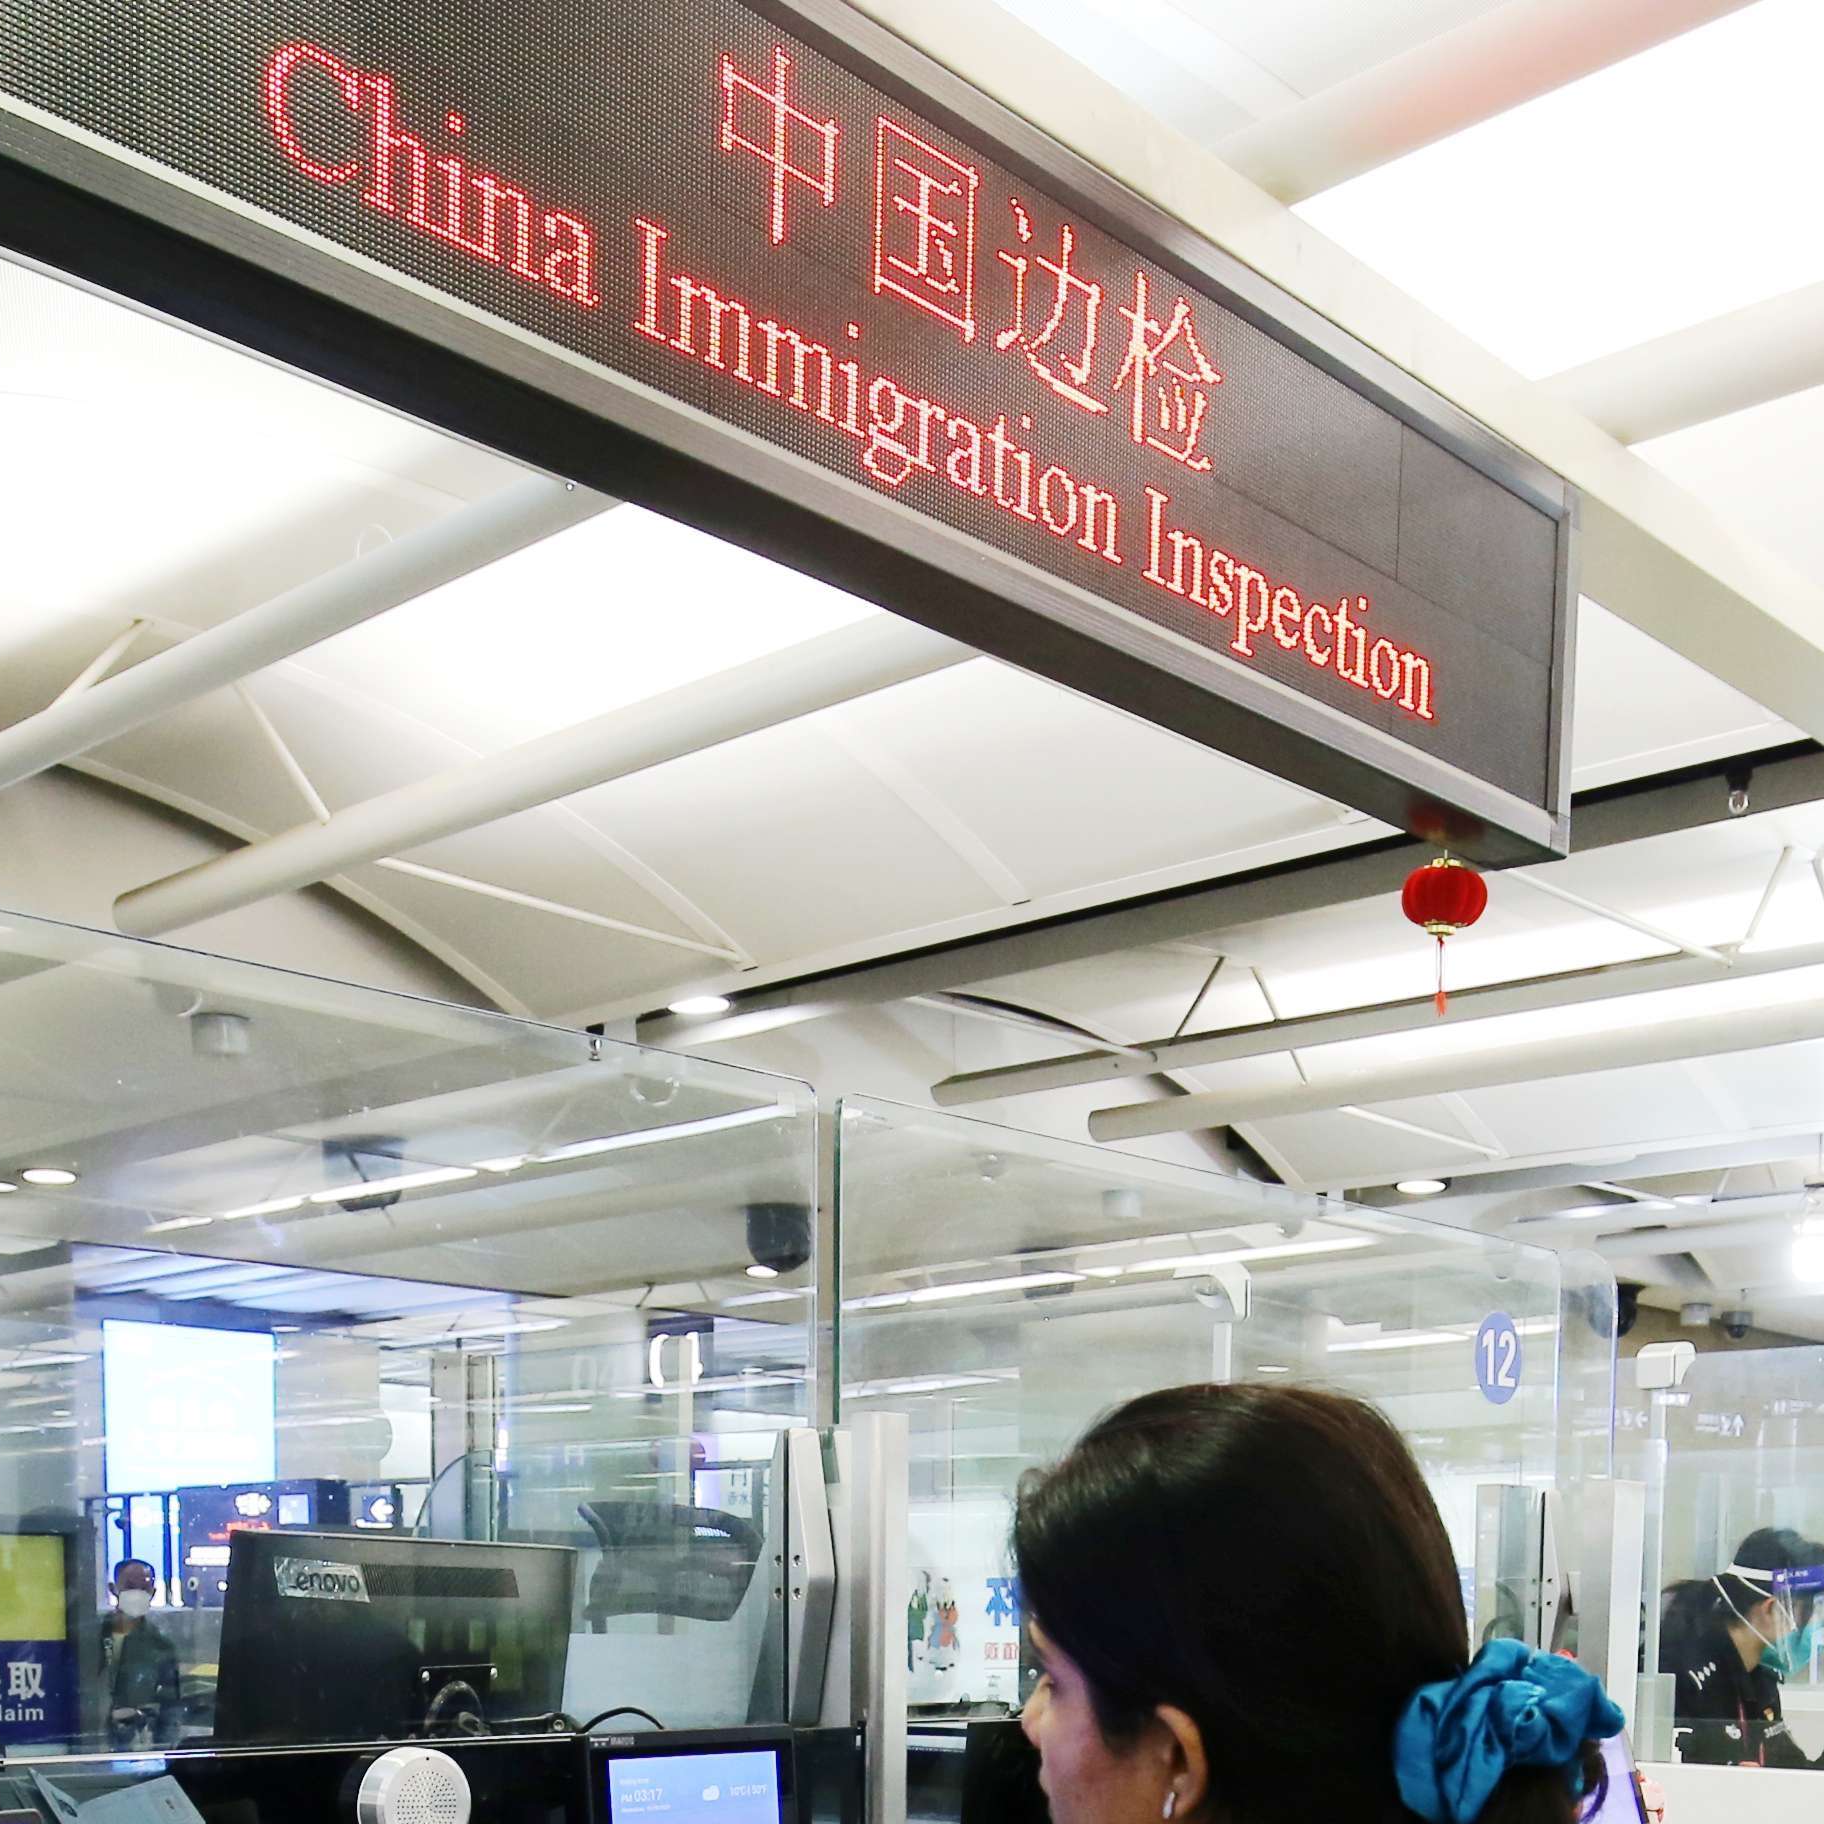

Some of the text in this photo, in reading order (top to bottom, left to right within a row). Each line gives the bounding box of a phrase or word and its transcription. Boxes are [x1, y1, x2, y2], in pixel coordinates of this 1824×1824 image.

[266, 38, 1435, 721] China Immigration Inspection
[717, 45, 1225, 473] 中国边检
[1481, 1327, 1517, 1389] 12
